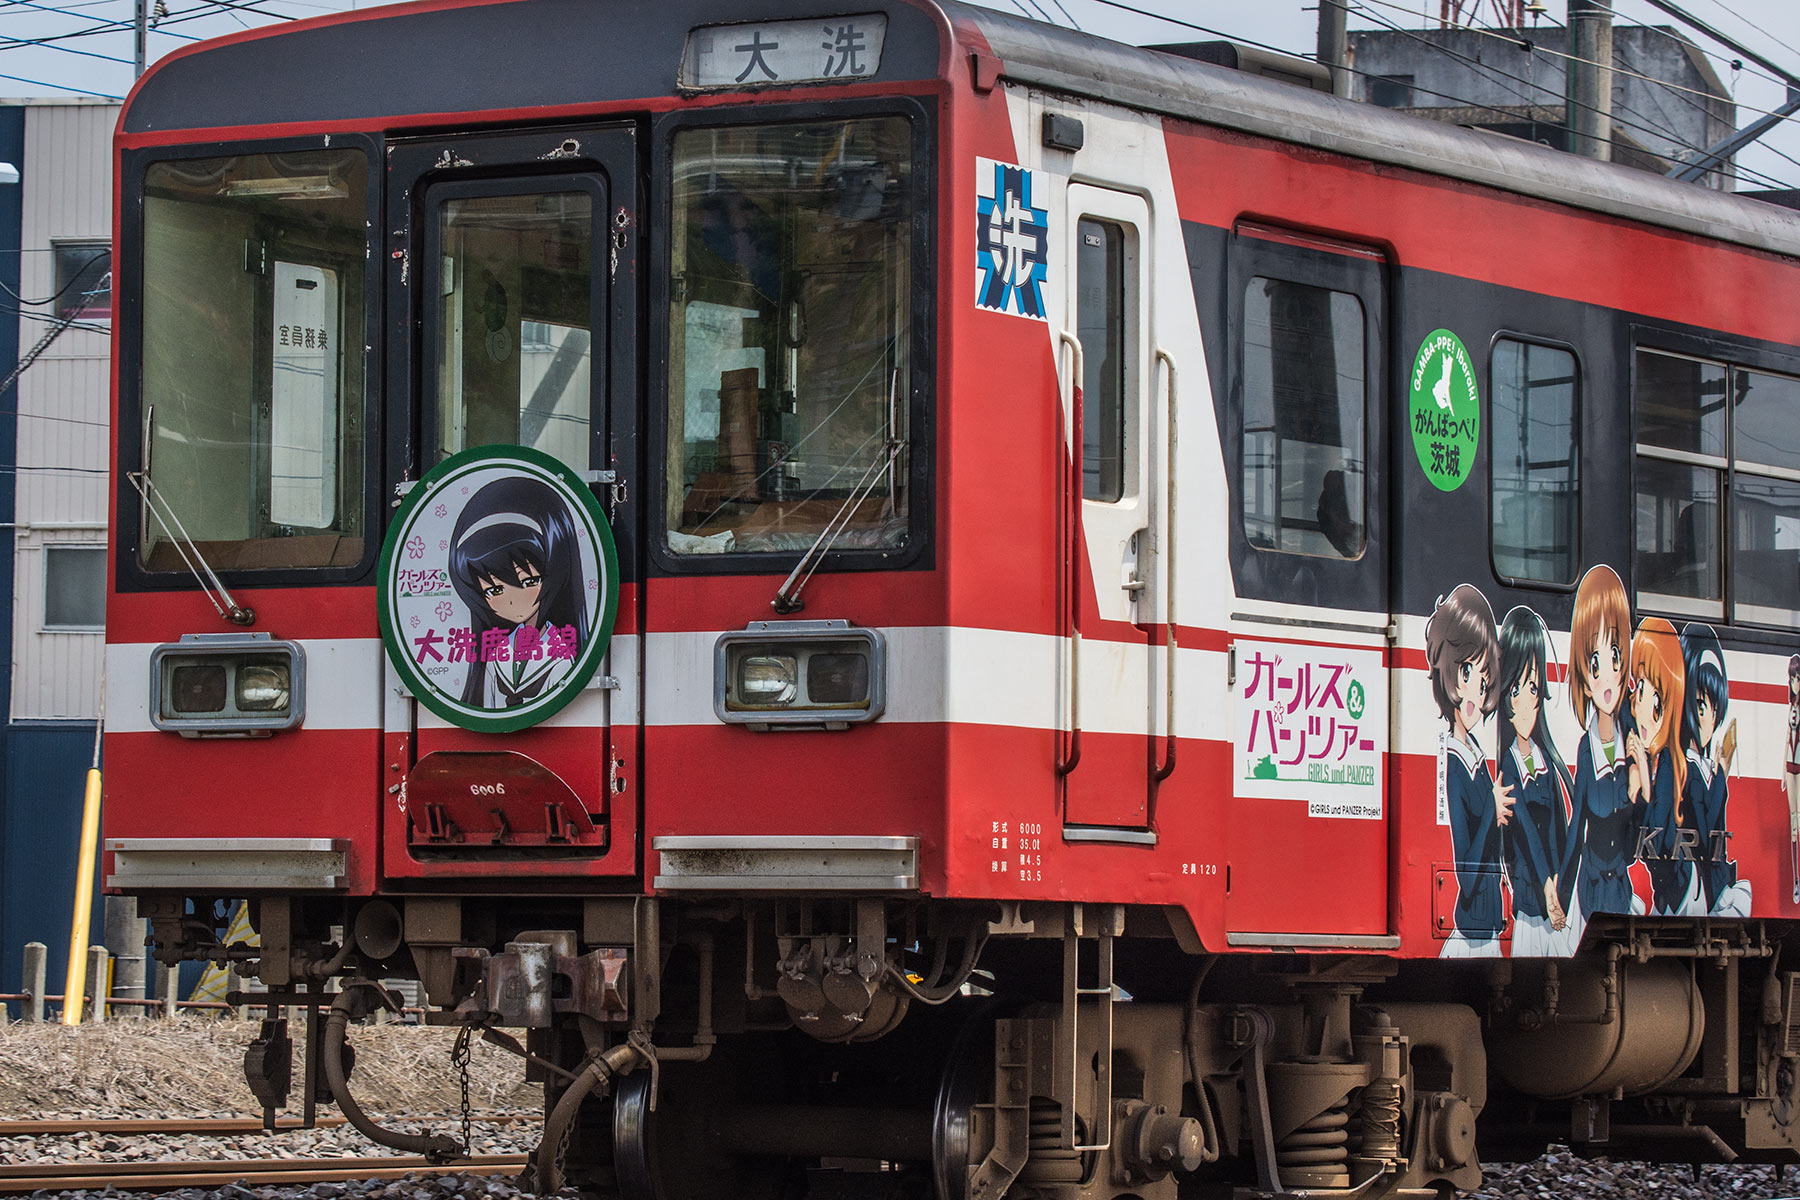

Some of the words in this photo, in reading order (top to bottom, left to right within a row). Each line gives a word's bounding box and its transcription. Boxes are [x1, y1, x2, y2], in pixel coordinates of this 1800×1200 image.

[735, 24, 866, 83] 大洗
[989, 189, 1037, 288] 洗
[1414, 336, 1455, 392] GAMBA-PPE!
[1456, 347, 1477, 401] Ibaraki
[1430, 441, 1461, 478] 茨城
[414, 624, 577, 665] 大洗鹿島線
[1247, 701, 1374, 766] パンツァー
[470, 782, 505, 796] 6006
[1308, 763, 1329, 781] GIRLS
[1331, 764, 1345, 783] und
[1346, 765, 1375, 785] PANZER
[1020, 822, 1041, 835] 6000
[1331, 805, 1341, 815] und
[1342, 805, 1362, 816] PANZER
[1363, 806, 1381, 817] Projekt
[1020, 838, 1040, 850] 35.0t
